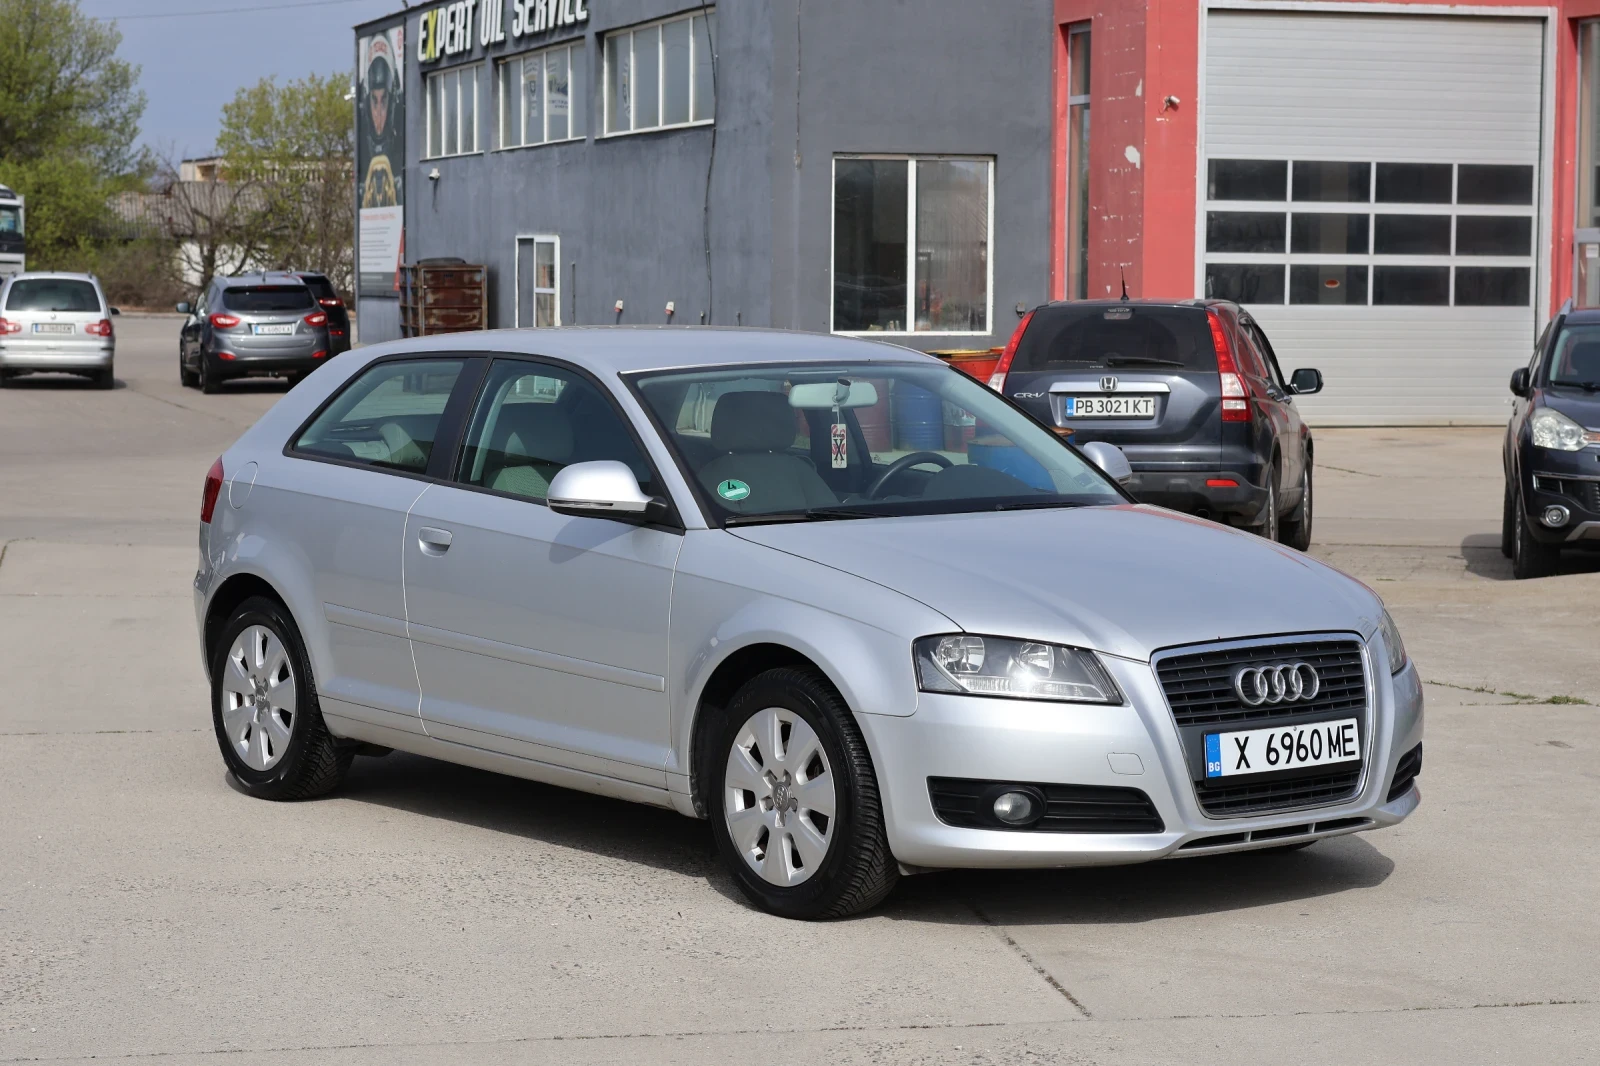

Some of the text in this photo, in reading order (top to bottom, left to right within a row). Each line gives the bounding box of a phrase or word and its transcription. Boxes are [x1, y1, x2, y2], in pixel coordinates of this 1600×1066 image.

[417, 0, 475, 62] EXPERT
[480, 0, 505, 46] OIL
[1075, 400, 1094, 413] PB
[1096, 400, 1129, 413] 3021
[1132, 400, 1152, 413] KT
[1208, 724, 1356, 772] BG X 6960 ME
